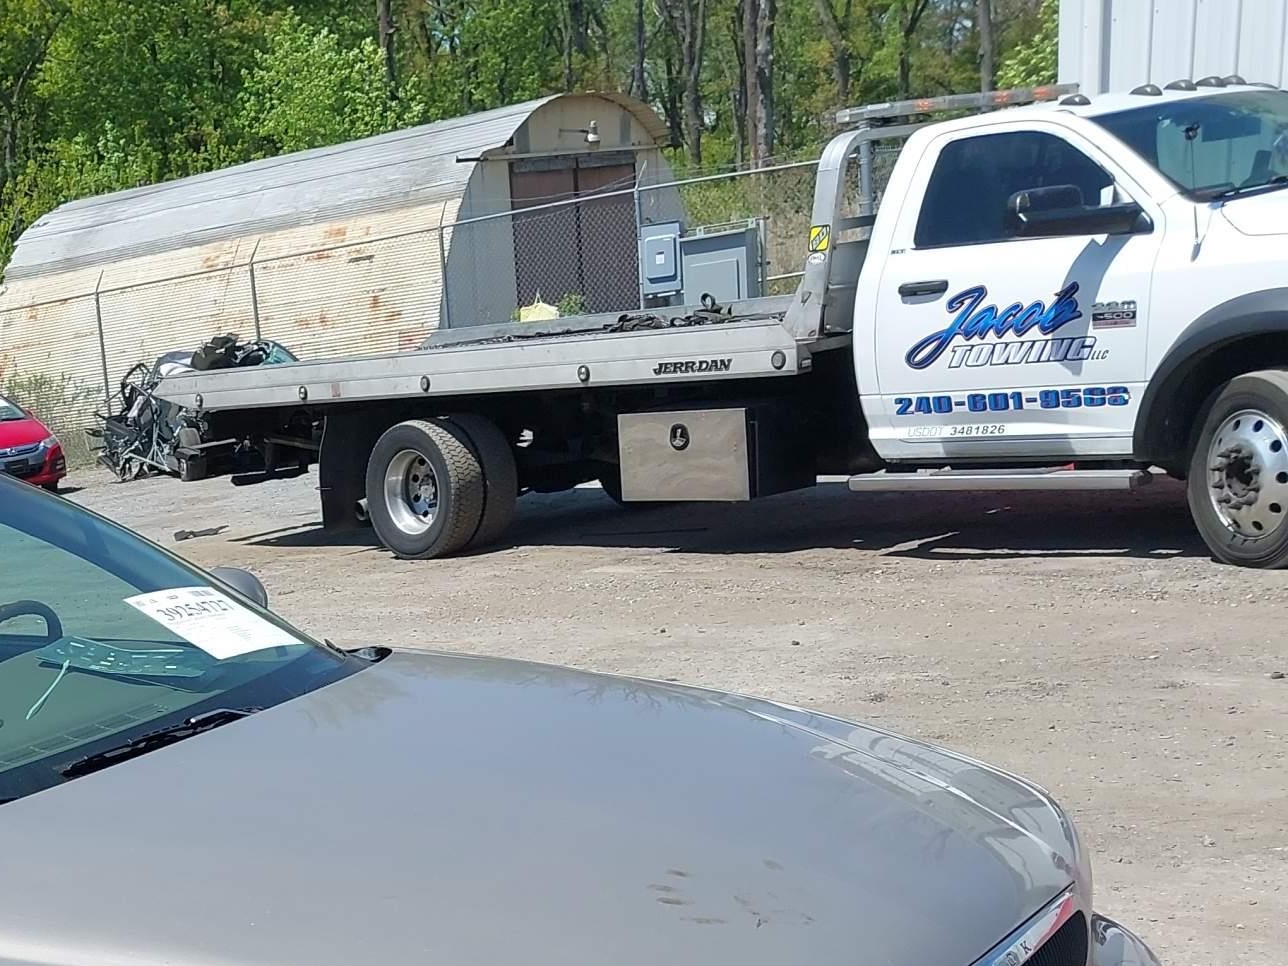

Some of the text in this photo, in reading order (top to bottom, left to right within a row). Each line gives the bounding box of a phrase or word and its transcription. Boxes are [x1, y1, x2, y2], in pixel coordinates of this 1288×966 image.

[905, 281, 1082, 369] Jacob
[948, 336, 1109, 369] TOWING LLC
[950, 424, 1005, 436] 3481826
